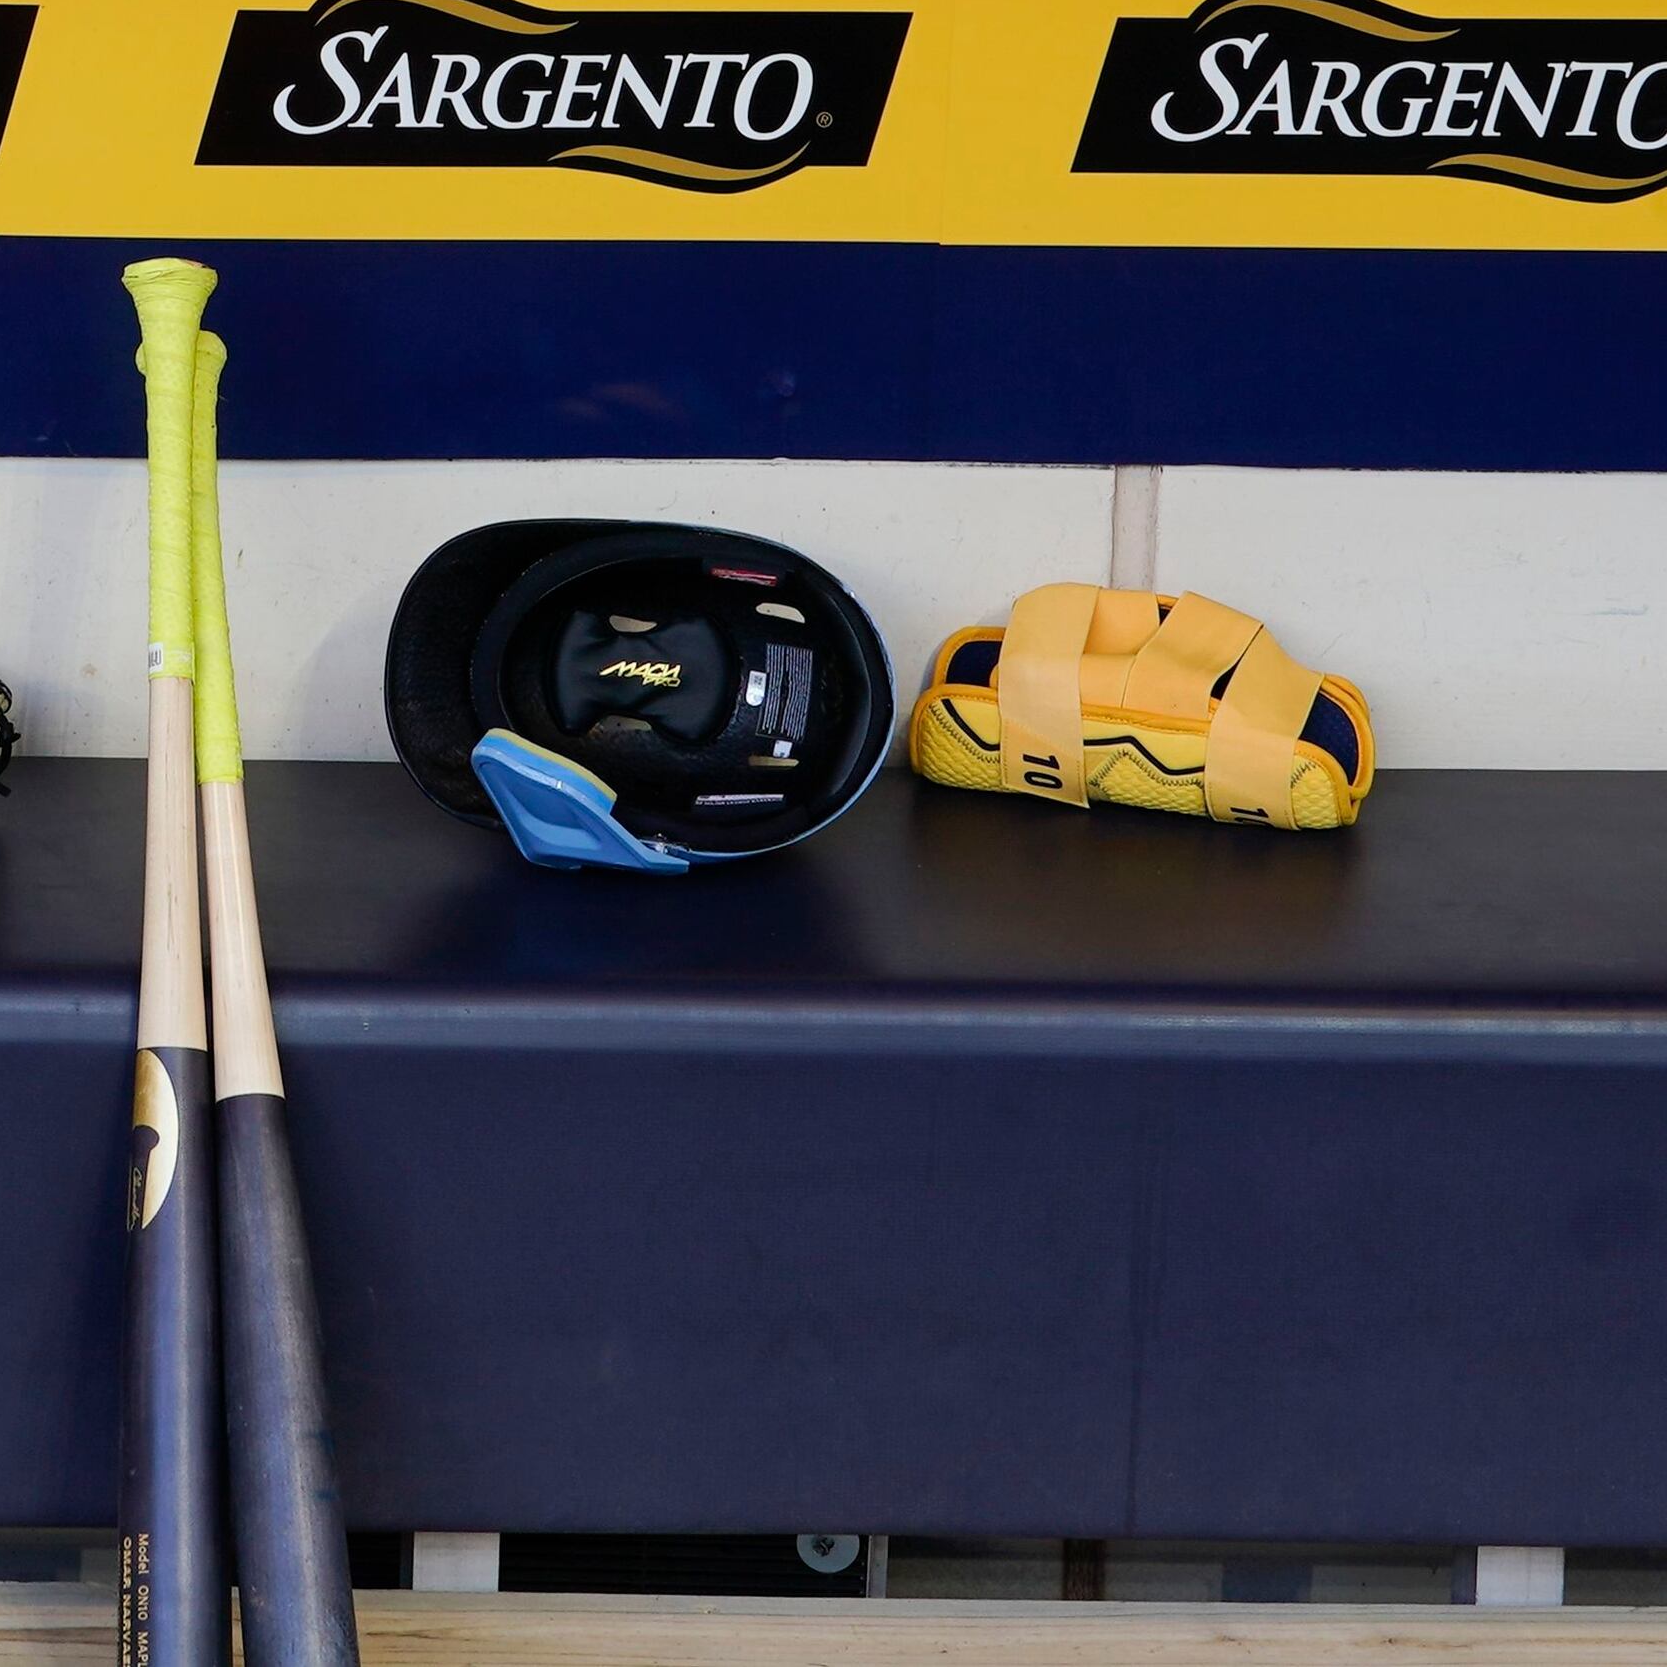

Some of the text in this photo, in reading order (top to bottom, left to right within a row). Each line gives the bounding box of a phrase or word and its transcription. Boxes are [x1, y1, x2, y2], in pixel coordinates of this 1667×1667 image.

[272, 25, 813, 140] SARGENTO
[1022, 754, 1063, 789] 10
[137, 1533, 149, 1574] Model
[123, 1536, 132, 1667] OMAR NARVAE
